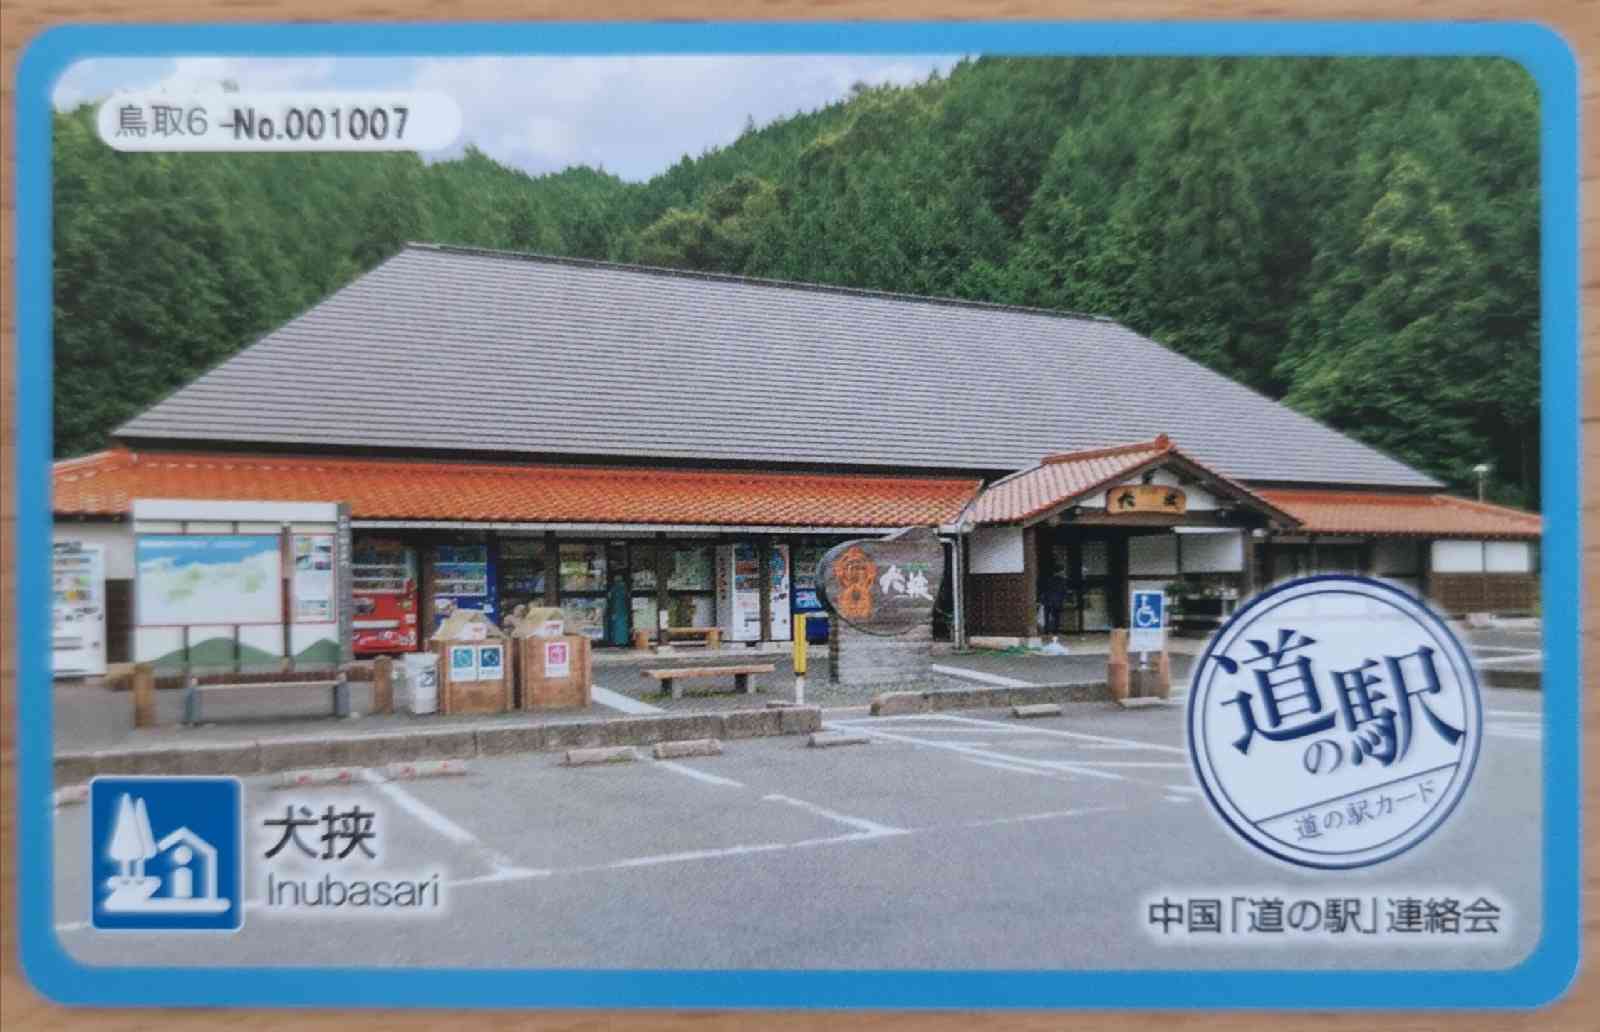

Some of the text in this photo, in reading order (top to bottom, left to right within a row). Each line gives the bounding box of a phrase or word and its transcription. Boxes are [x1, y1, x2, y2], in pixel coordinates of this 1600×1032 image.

[115, 103, 209, 138] 鳥取6
[1208, 628, 1467, 775] 道の駅
[263, 804, 377, 860] 犬挟
[1295, 779, 1435, 840] 道の駅カード
[267, 872, 440, 907] Inubasari
[1148, 896, 1502, 935] 中国「道の駅」連絡会
